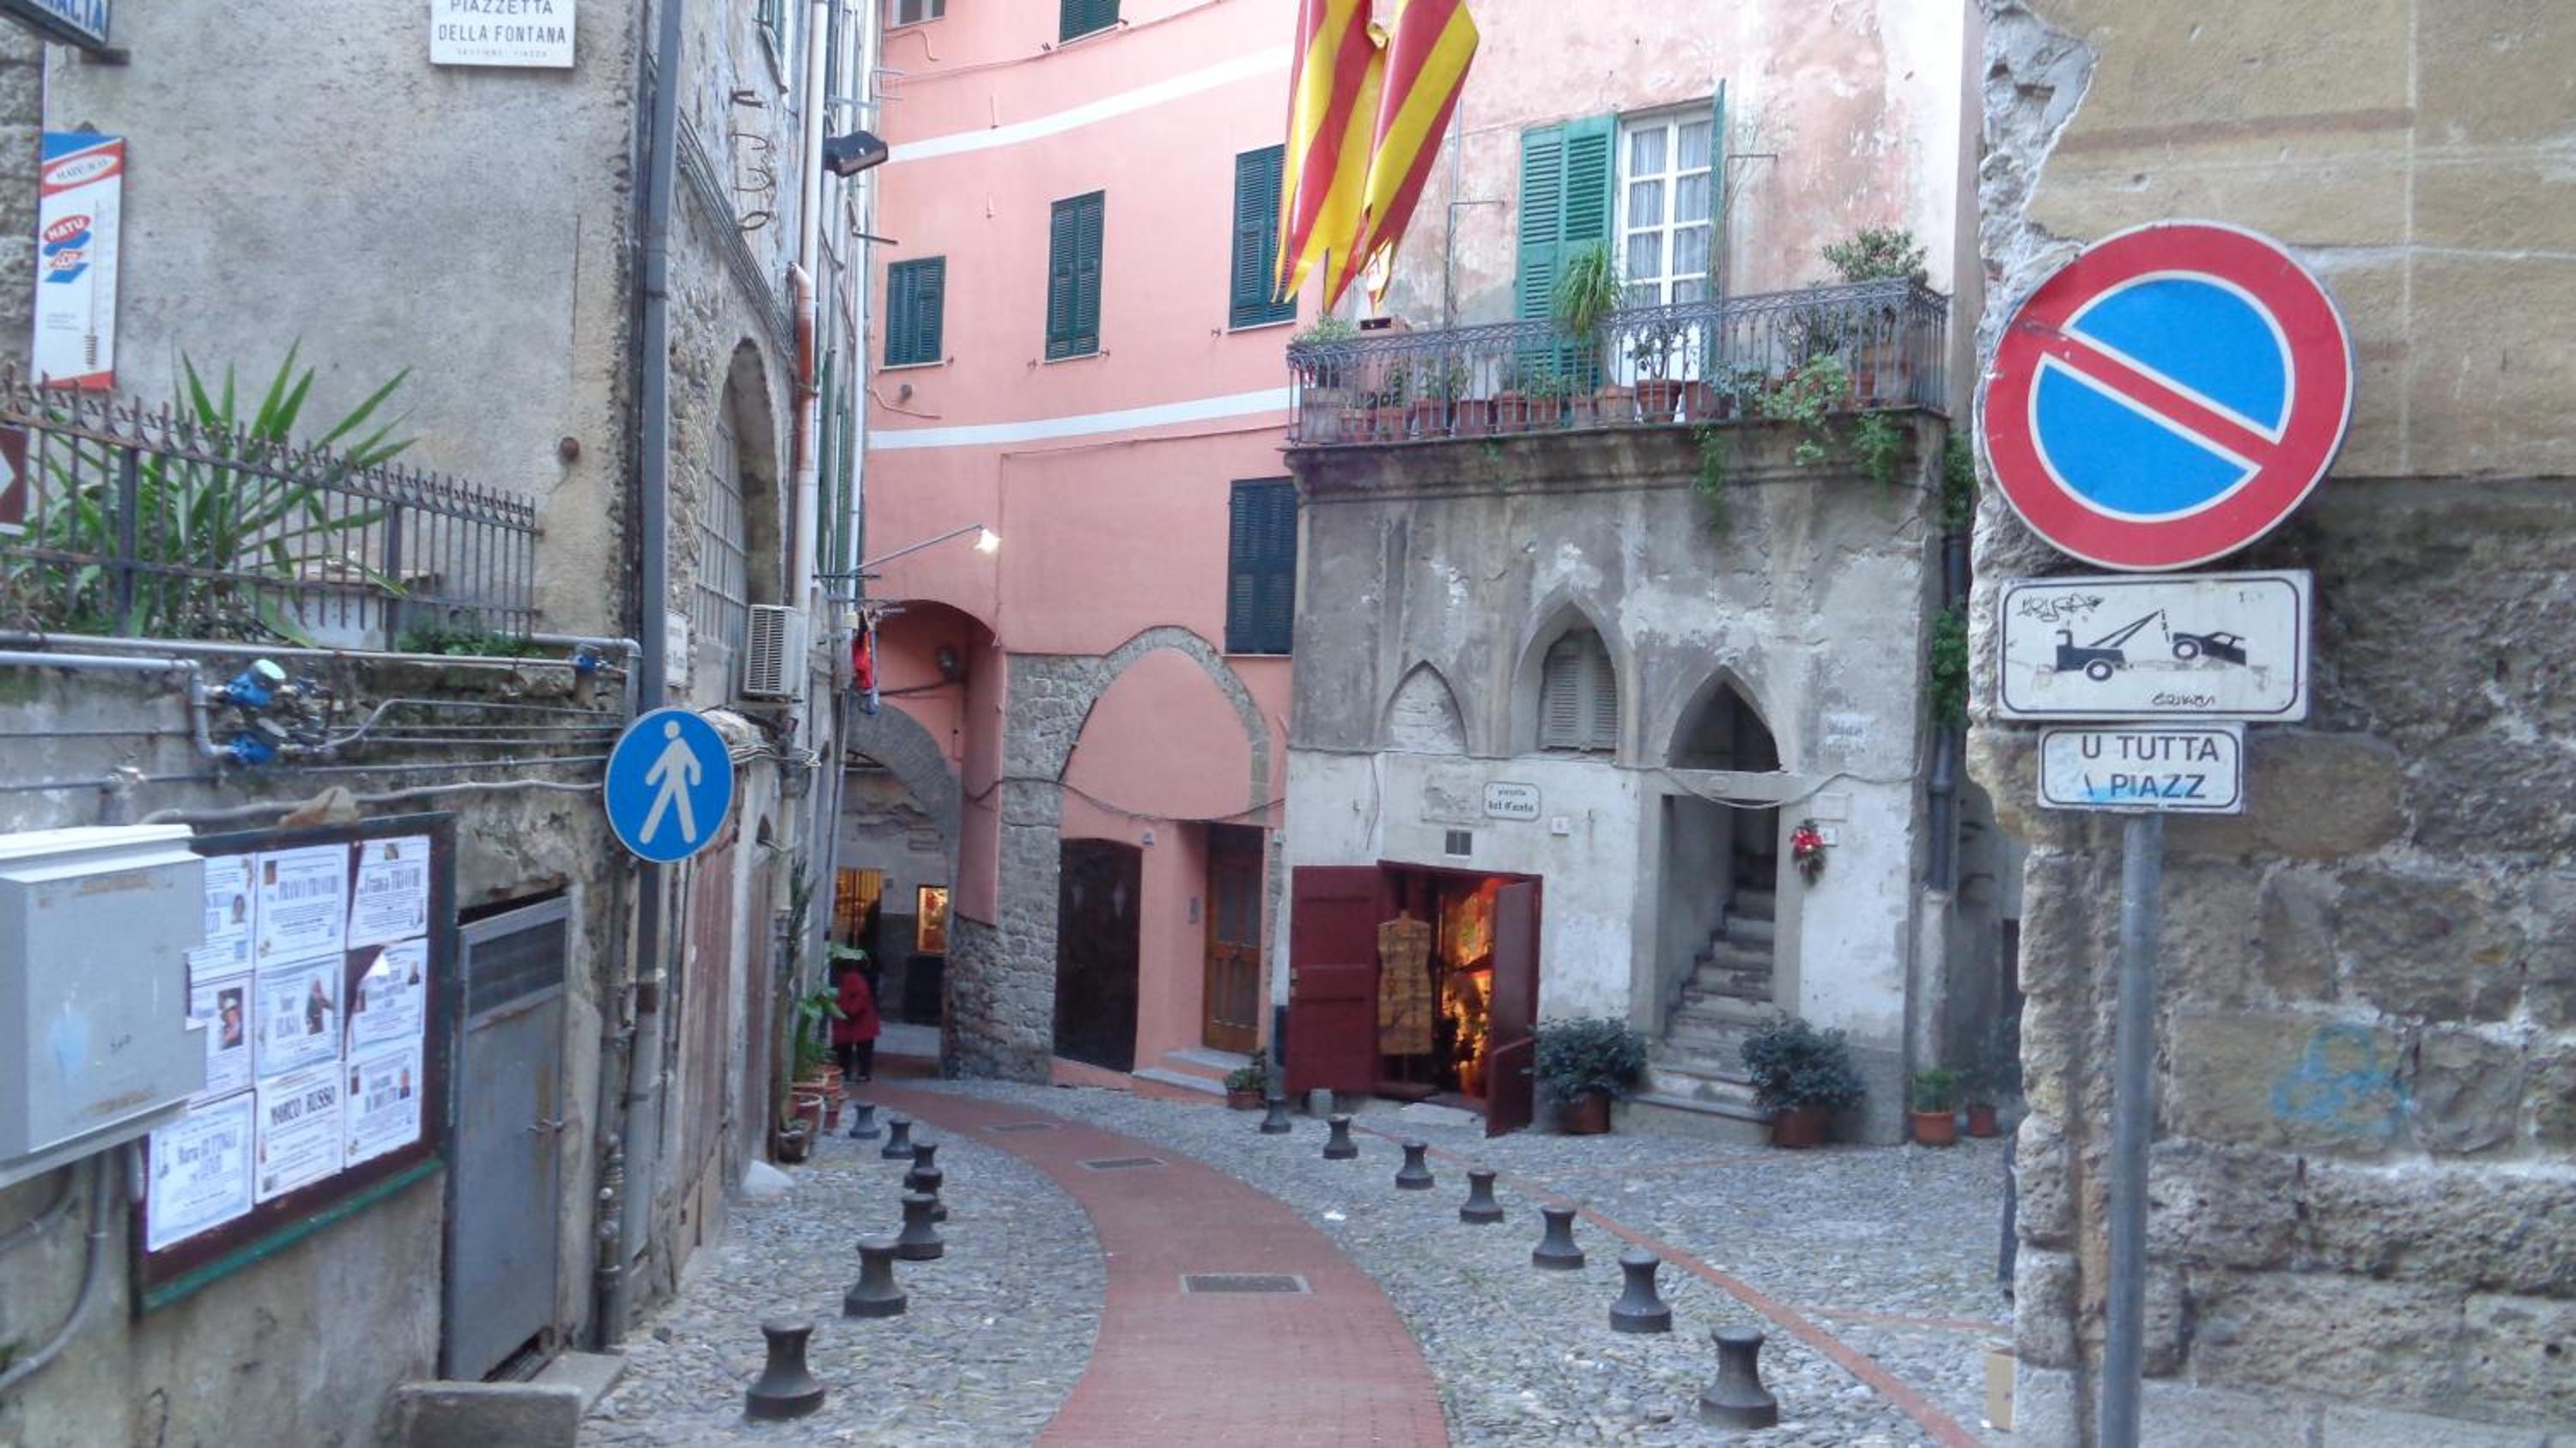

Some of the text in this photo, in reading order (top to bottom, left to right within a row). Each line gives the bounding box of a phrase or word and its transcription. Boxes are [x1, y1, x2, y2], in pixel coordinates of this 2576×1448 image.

[450, 0, 554, 15] PIAZZETTA
[438, 24, 567, 44] DELLA FONTANA
[2116, 735, 2219, 761] TUTTA
[270, 1098, 301, 1127] MARCO
[306, 1085, 336, 1114] RUSSO
